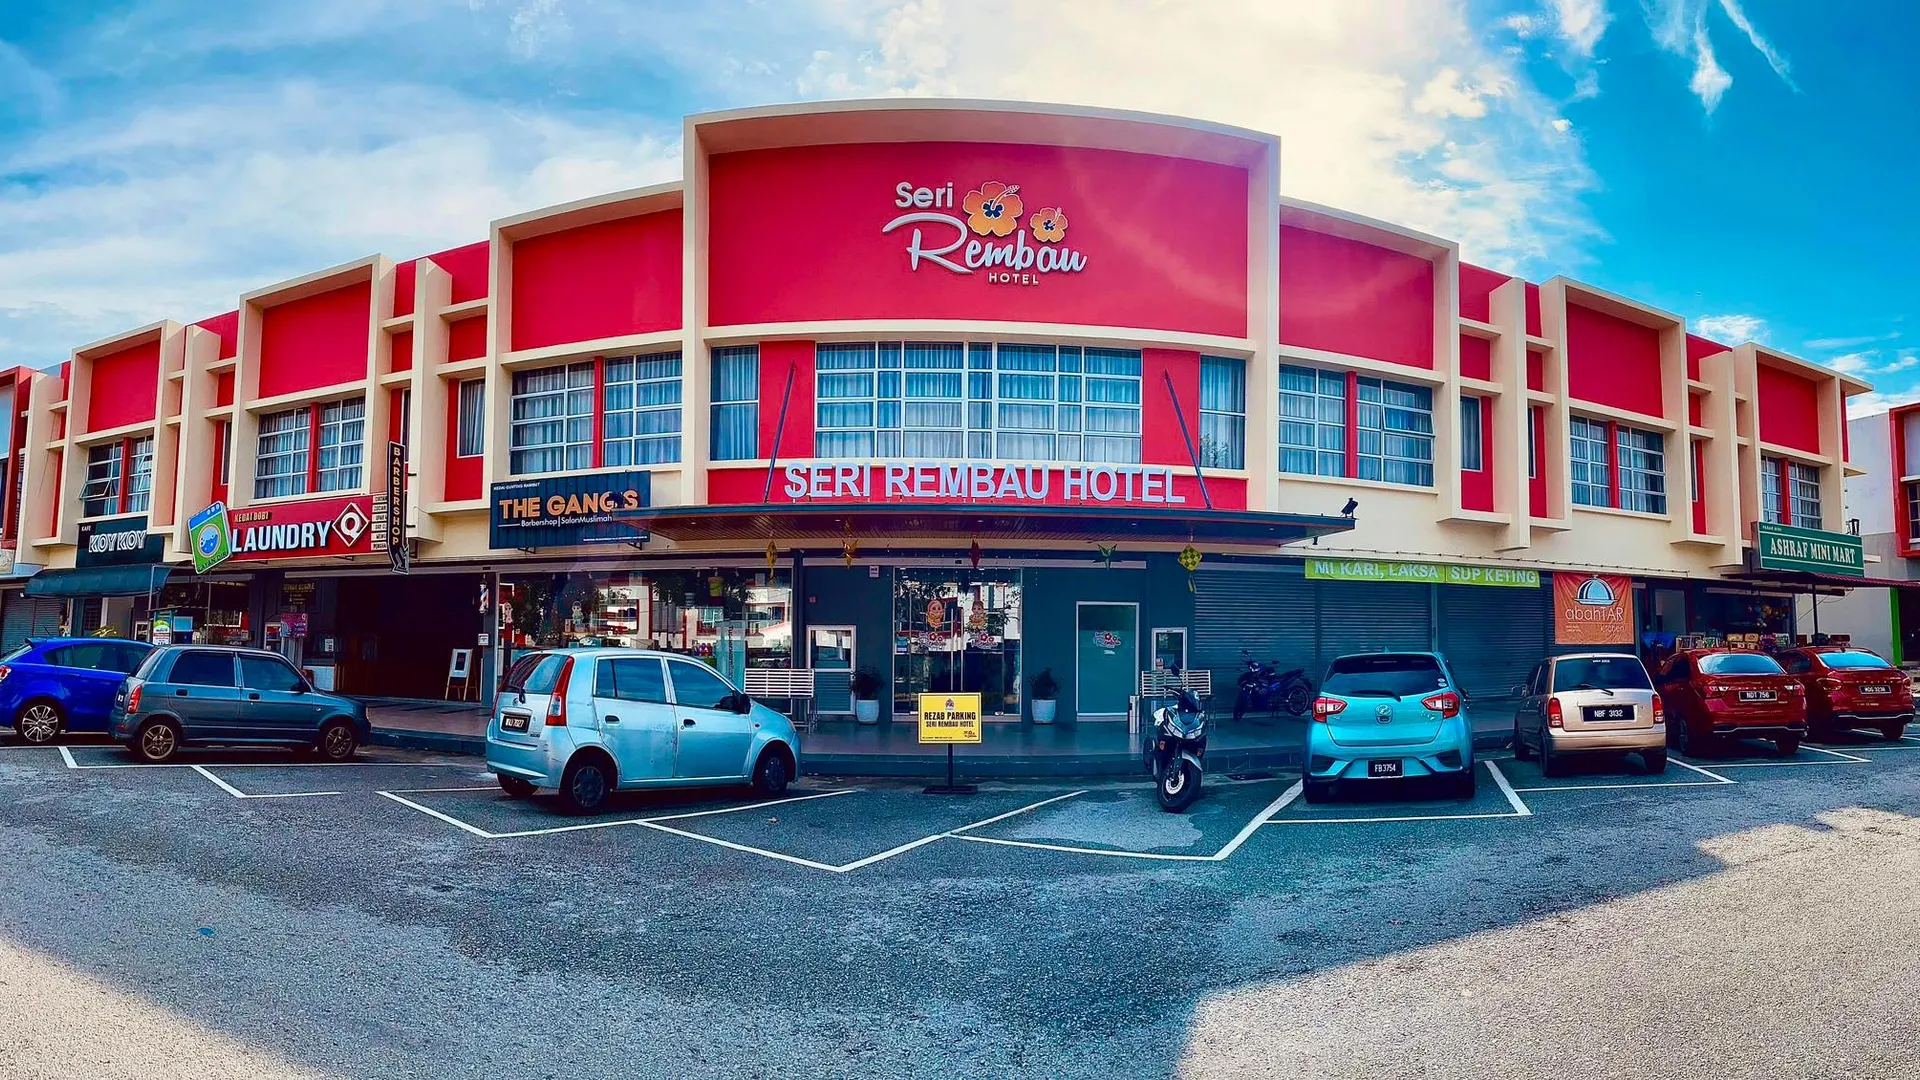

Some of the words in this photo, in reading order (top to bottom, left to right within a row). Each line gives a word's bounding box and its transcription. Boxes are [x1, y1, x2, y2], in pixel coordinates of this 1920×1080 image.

[895, 181, 953, 208] Seri
[881, 212, 1088, 274] Rembau
[989, 272, 1039, 284] HOTEL
[784, 462, 871, 498] SERI
[886, 462, 1049, 500] REMBAU
[1064, 464, 1186, 503] HOTEL
[392, 447, 401, 545] BARBERSHOP
[499, 497, 541, 519] THE
[232, 521, 331, 553] LAUNDRY
[341, 512, 360, 539] Q
[1770, 538, 1808, 558] ASHRAF
[1810, 543, 1830, 561] MINI
[1832, 546, 1855, 564] MART
[1314, 560, 1334, 575] MI
[1340, 562, 1384, 579] KARI,
[1389, 563, 1438, 578] LAKSA
[1451, 566, 1480, 581] SUP
[1485, 568, 1536, 583] KETING
[1565, 606, 1623, 621] abahTAR
[924, 712, 945, 720] REZAB
[947, 712, 976, 720] PARKING
